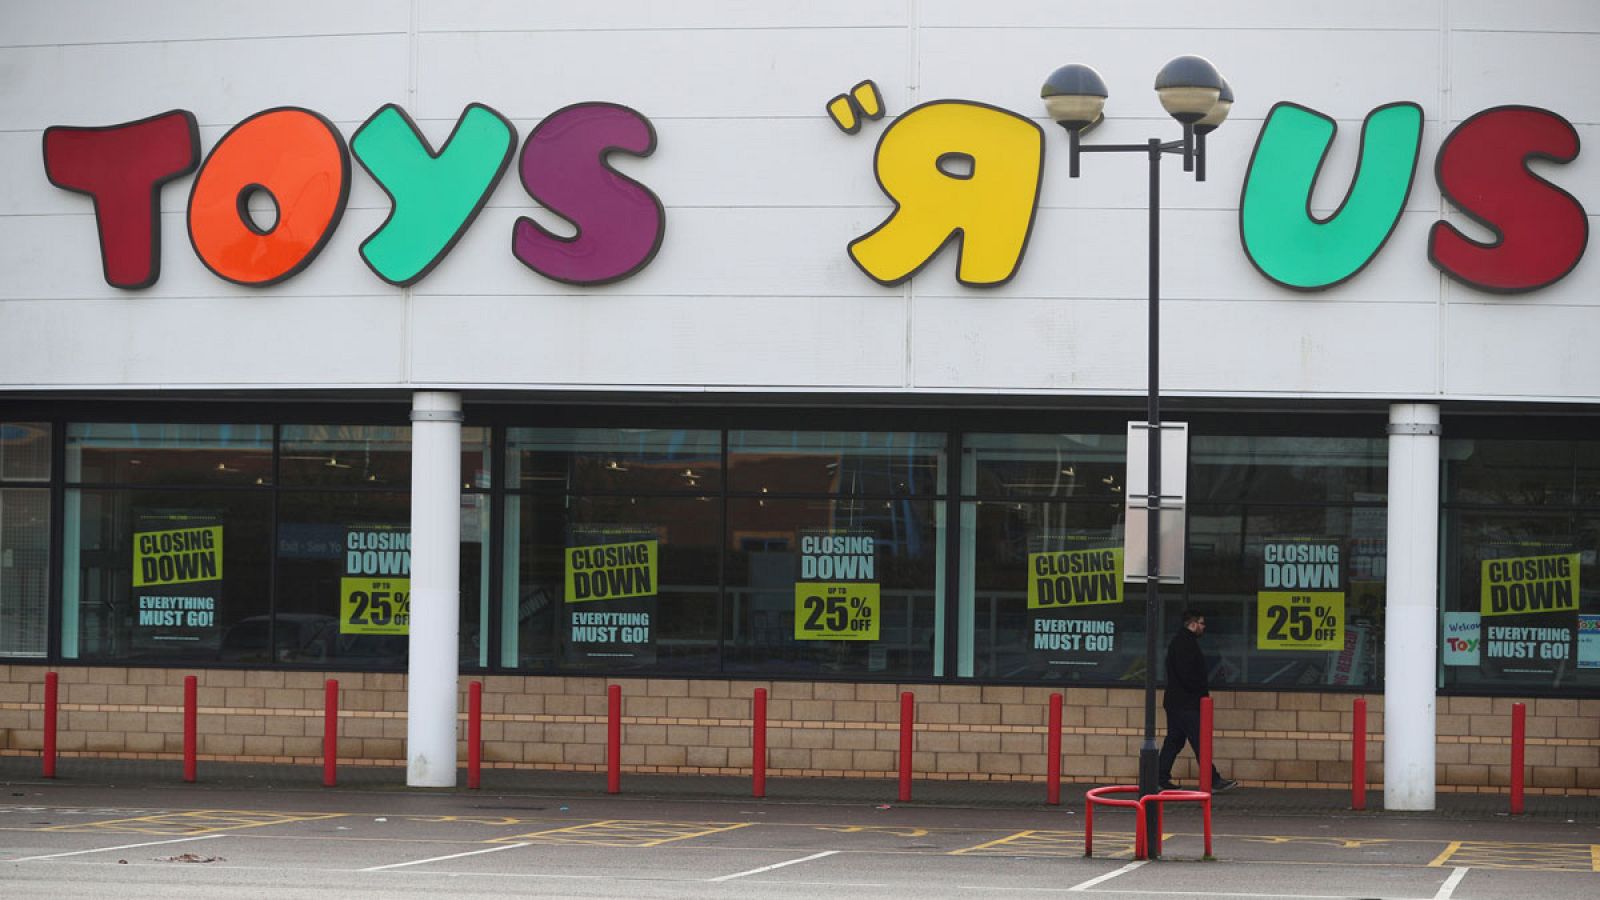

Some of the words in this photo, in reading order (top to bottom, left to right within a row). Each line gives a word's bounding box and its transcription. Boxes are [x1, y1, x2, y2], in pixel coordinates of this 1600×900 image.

[42, 101, 666, 289] TOYS
[1239, 101, 1590, 294] US
[140, 529, 214, 554] CLOSING
[801, 535, 875, 555] CLOSING
[571, 543, 649, 570] CLOSING
[1264, 543, 1340, 562] CLOSING
[141, 551, 217, 583] DOWN
[801, 555, 875, 580] DOWN
[1035, 551, 1115, 577] CLOSING
[1489, 556, 1571, 583] CLOSING
[574, 566, 652, 599] DOWN
[1264, 563, 1340, 589] DOWN
[1037, 573, 1117, 606] DOWN
[1490, 580, 1573, 613] DOWN
[139, 595, 214, 610] EVERYTHING
[1291, 596, 1301, 604] UP
[139, 610, 183, 627] MUST
[187, 611, 214, 627] GO!
[394, 613, 410, 626] OF
[571, 612, 649, 626] EVERYTHING
[850, 618, 872, 631] OFF
[1034, 619, 1115, 633] EVERYTHING
[571, 626, 618, 643] MUST
[621, 627, 649, 643] GO!
[1034, 632, 1081, 650] MUST
[1085, 634, 1115, 652] GO!
[1315, 628, 1337, 641] OFF
[1487, 626, 1571, 641] EVERYTHING
[1487, 641, 1537, 658] MUST
[1539, 642, 1571, 660] GO!
